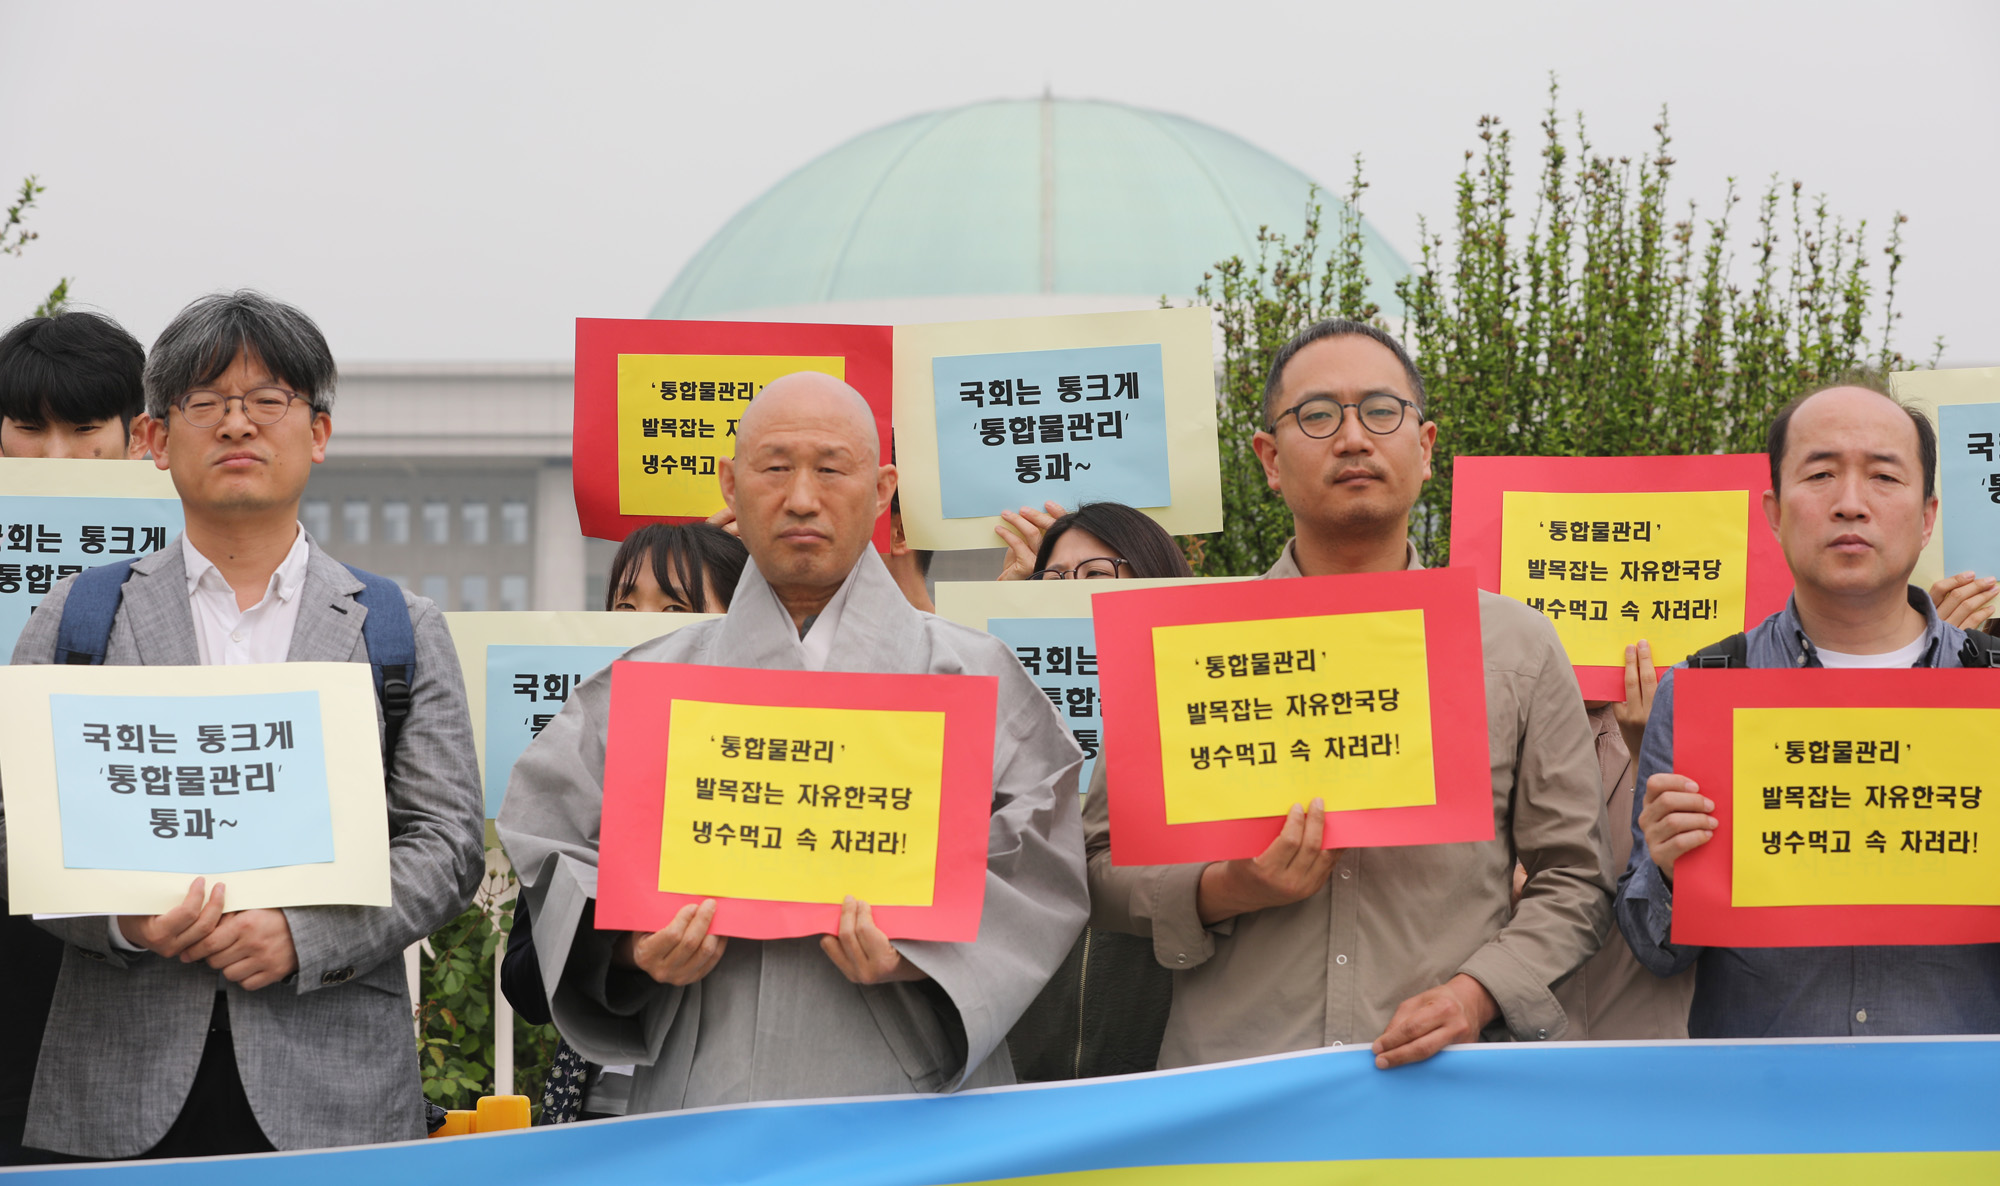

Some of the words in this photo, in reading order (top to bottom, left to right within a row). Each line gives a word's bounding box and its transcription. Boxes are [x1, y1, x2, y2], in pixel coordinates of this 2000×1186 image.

[959, 378, 1042, 408] 국회는
[1057, 371, 1140, 403] 통크게
[642, 417, 716, 438] 발목잡는
[973, 410, 1129, 447] '통합물관리'
[1967, 432, 2000, 462] 국
[642, 454, 716, 476] 냉수먹고
[1015, 452, 1091, 484] 통과~
[79, 525, 166, 555] 통크게
[1539, 520, 1661, 543] ‘통합물관리’
[1528, 559, 1609, 582] 발목잡는
[1619, 559, 1722, 582] 자유한국당
[1620, 600, 1640, 622] 속
[1651, 598, 1718, 622] 차려라!
[1016, 646, 1098, 675] 국회는
[1193, 648, 1327, 679] ‘통합물관리’
[513, 673, 581, 702] 국회
[1187, 697, 1273, 725] 발목잡는
[1286, 688, 1400, 717] 자유한국당
[83, 723, 178, 754] 국회는
[197, 720, 294, 754] 통크게
[710, 735, 846, 764] ‘통합물관리’
[1190, 741, 1277, 770] 냉수먹고
[1290, 739, 1311, 762] 속
[1324, 733, 1399, 760] 차려라!
[1774, 740, 1911, 764] ‘통합물관리’
[99, 762, 282, 797] '통합물관리'
[696, 777, 784, 805] 발목잡는
[797, 784, 912, 810] 자유한국당
[1762, 785, 1851, 810] 발목잡는
[1864, 785, 1983, 810] 자유한국당
[149, 808, 238, 840] 통과~
[693, 821, 782, 849] 냉수먹고
[796, 828, 817, 851] 속
[831, 829, 906, 855] 차려라!
[1762, 830, 1851, 855] 냉수먹고
[1865, 830, 1887, 854] 속
[1900, 830, 1978, 854] 차려라!
